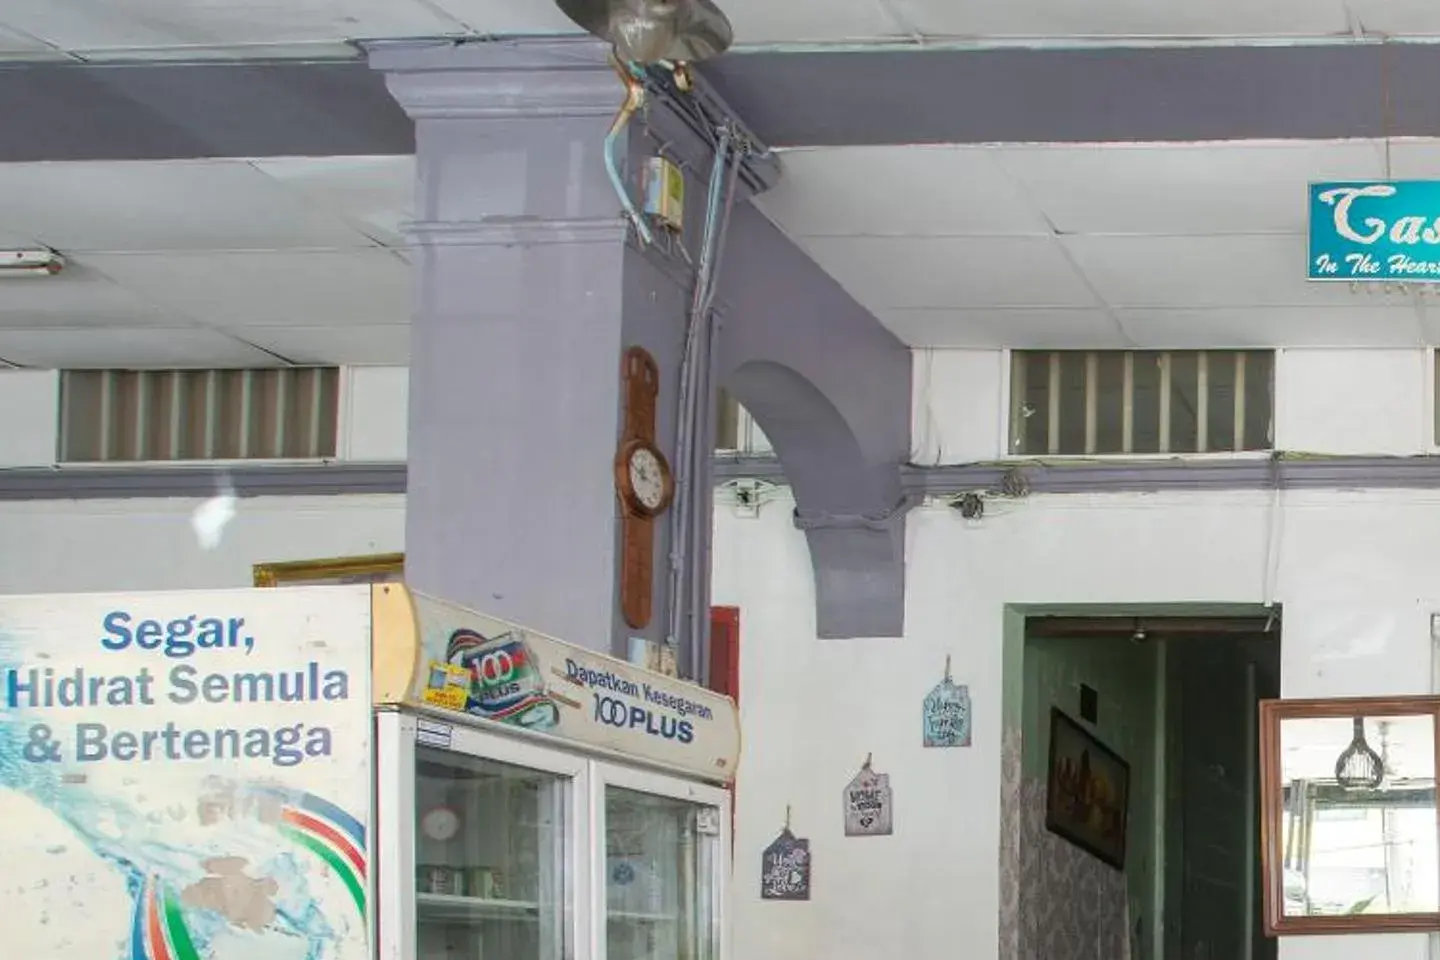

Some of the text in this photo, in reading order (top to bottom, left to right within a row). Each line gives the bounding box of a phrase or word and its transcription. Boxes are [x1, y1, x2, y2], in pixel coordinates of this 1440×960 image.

[1315, 254, 1338, 274] In
[1345, 253, 1381, 275] The
[100, 611, 255, 659] Segar,
[6, 662, 349, 708] Hidrat Semula
[472, 650, 513, 688] 100
[565, 658, 713, 721] Dapatkan Kesegaran
[593, 693, 695, 744] 100PLUS
[22, 721, 332, 767] & Bertenaga
